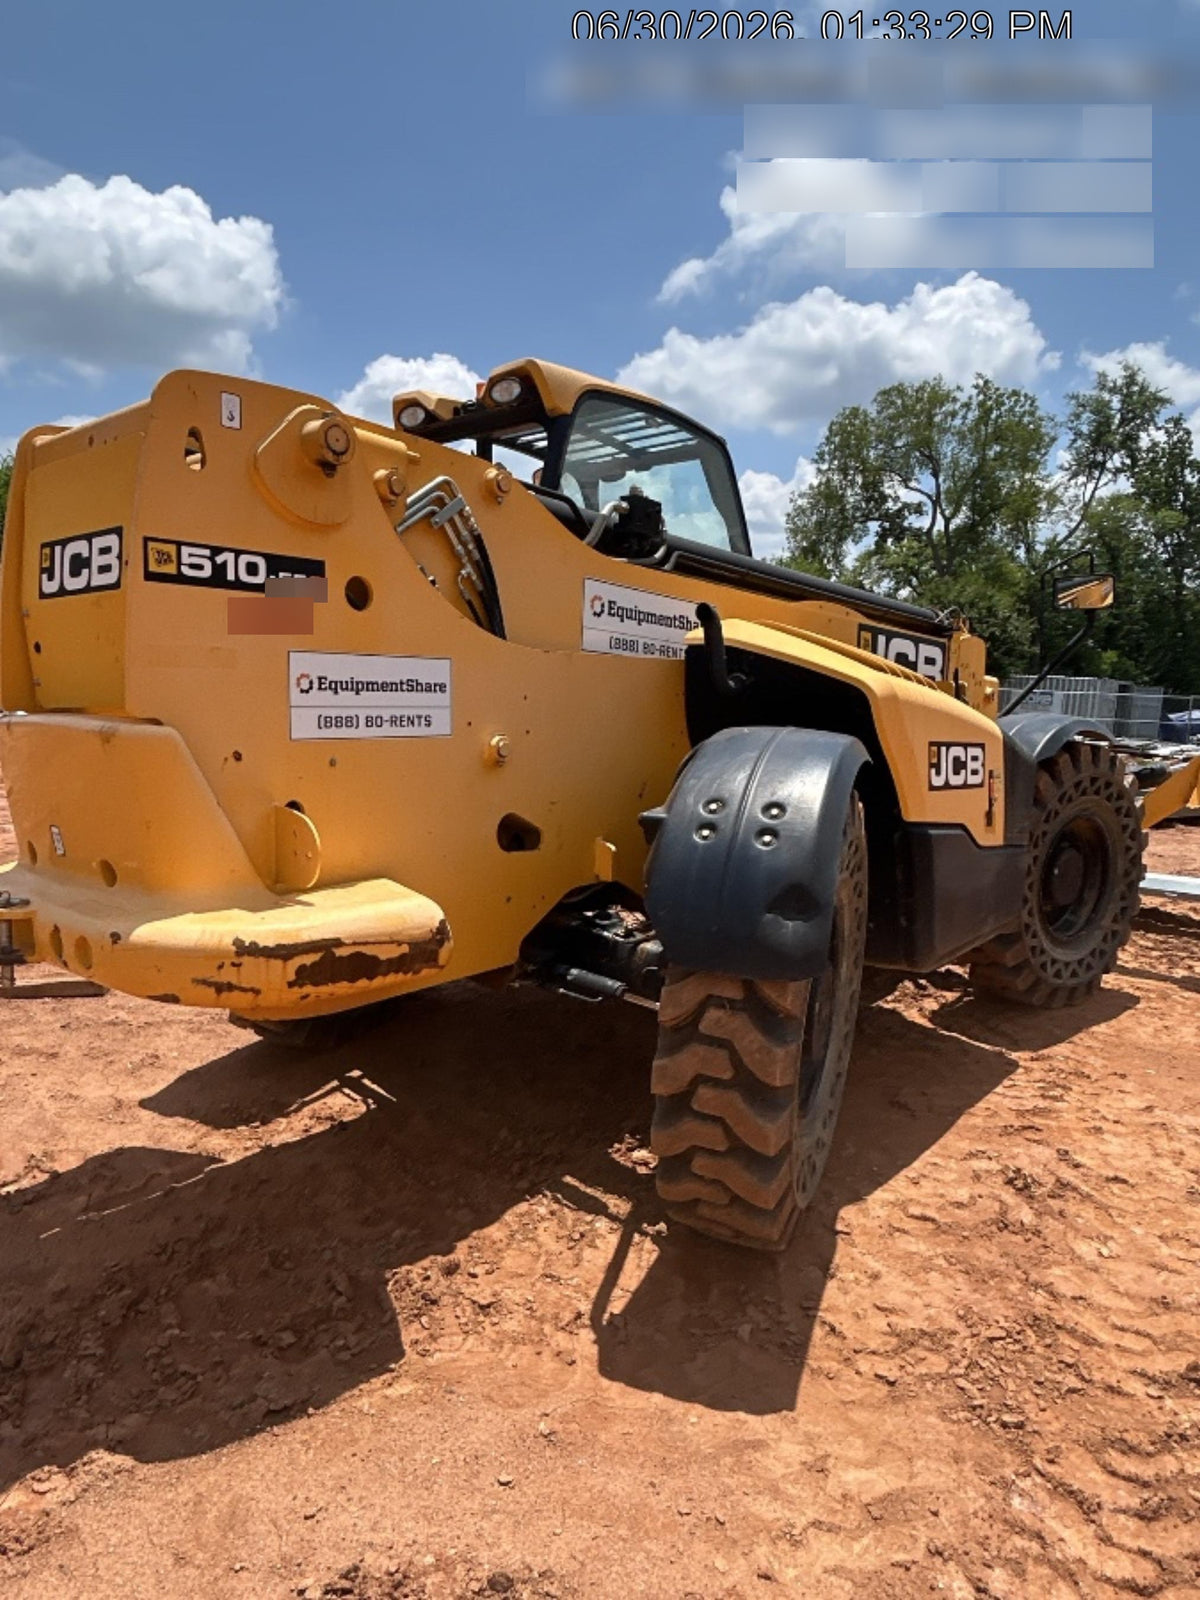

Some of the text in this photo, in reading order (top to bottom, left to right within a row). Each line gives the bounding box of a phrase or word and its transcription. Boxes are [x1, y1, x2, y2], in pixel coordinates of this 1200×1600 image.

[41, 533, 120, 595] JCB
[607, 600, 700, 632] EquipmentSha
[608, 636, 639, 653] (888)
[316, 675, 447, 696] EquipmentShare
[317, 714, 360, 730] (888)
[930, 746, 984, 787] JCB
